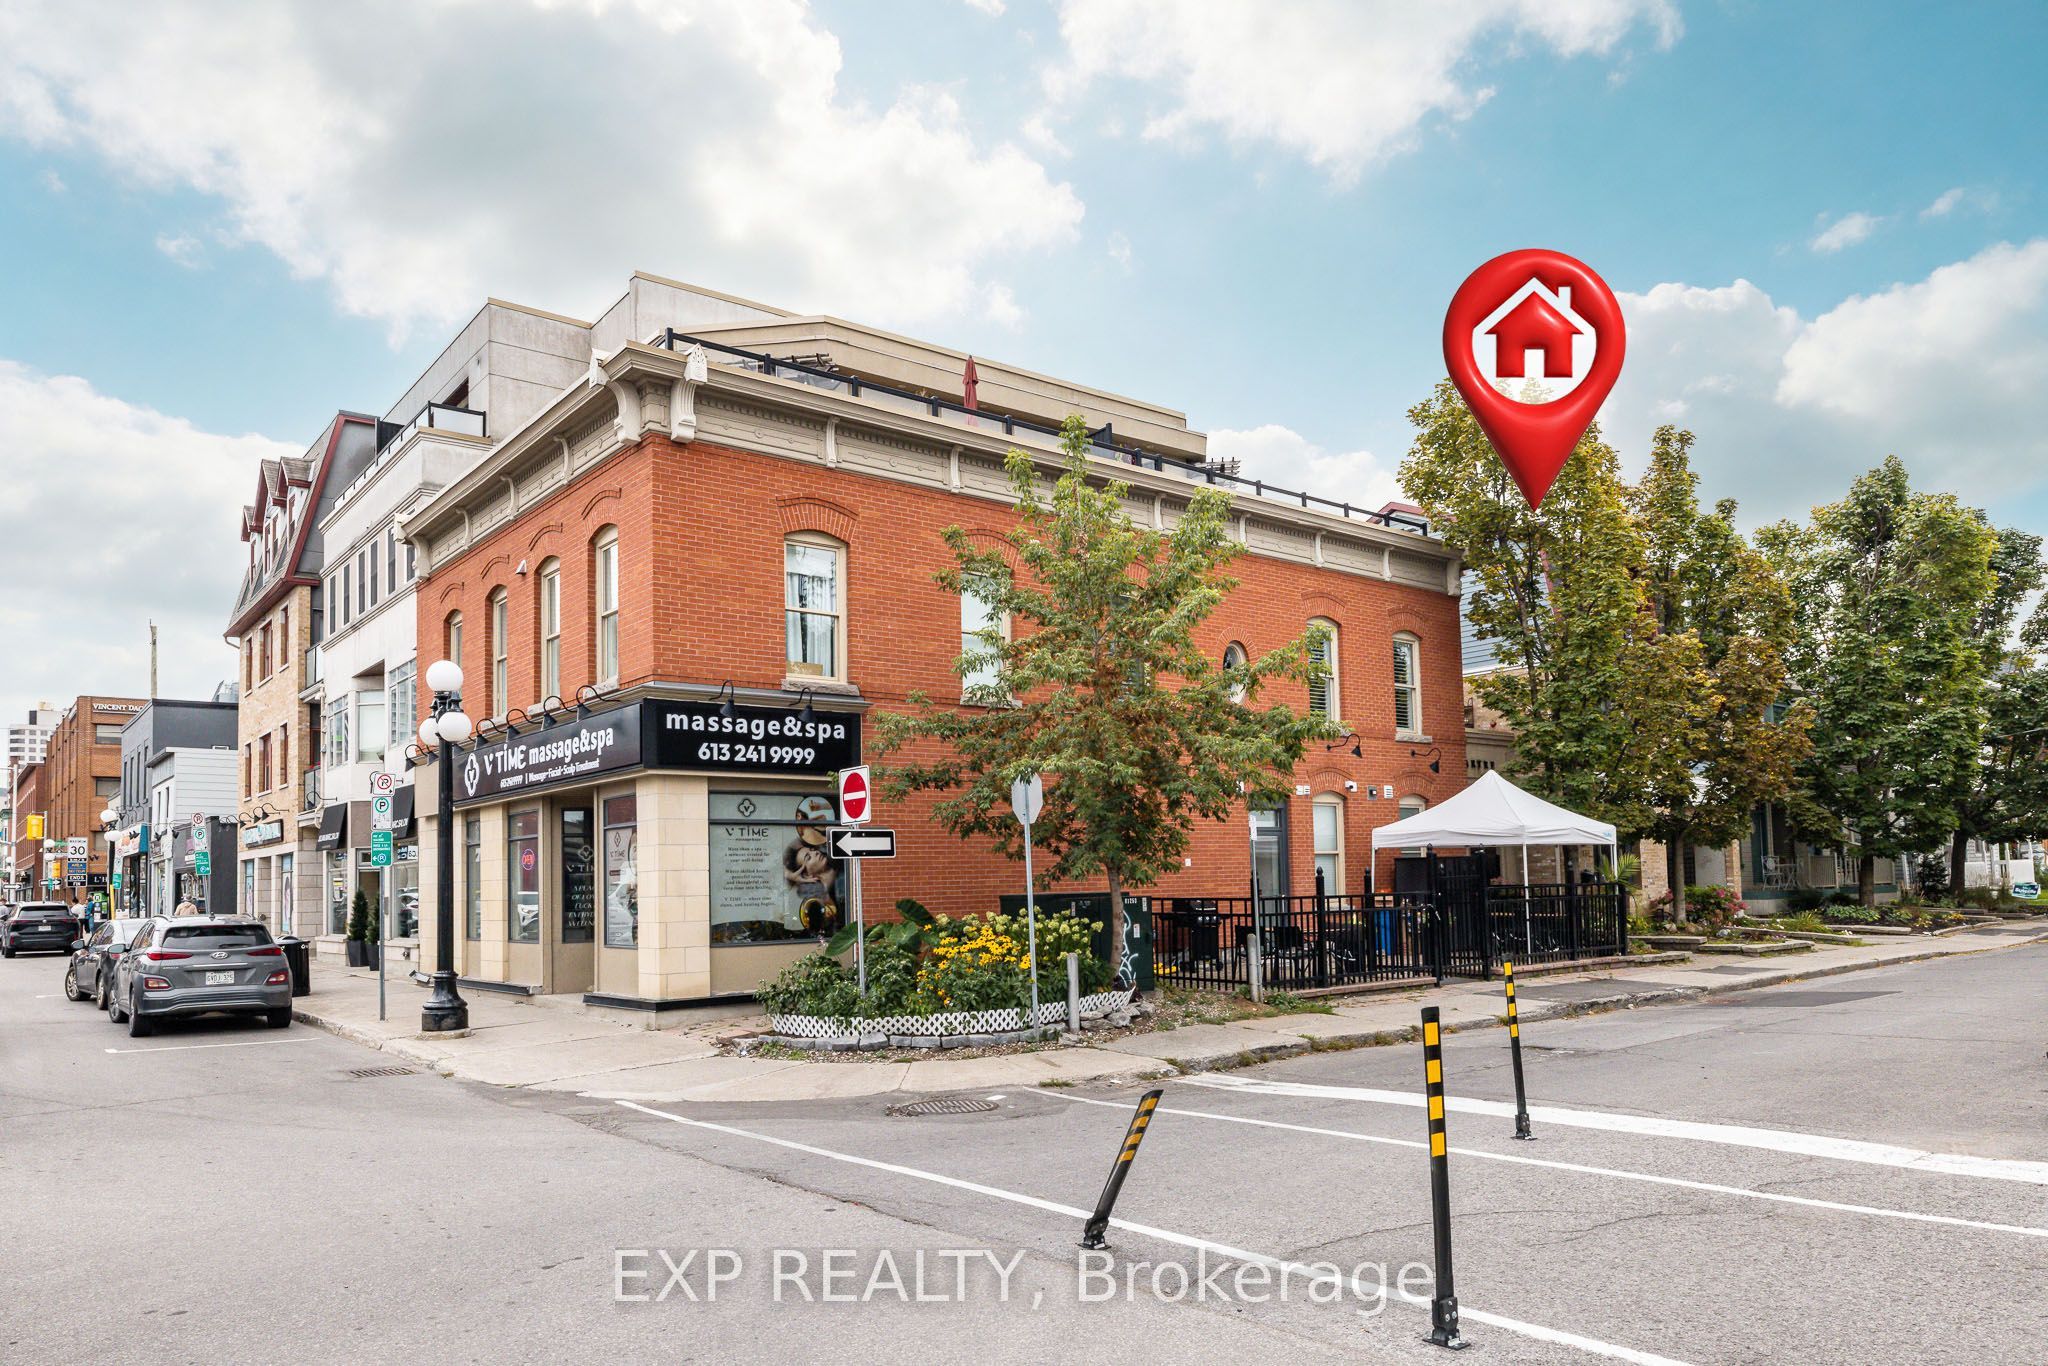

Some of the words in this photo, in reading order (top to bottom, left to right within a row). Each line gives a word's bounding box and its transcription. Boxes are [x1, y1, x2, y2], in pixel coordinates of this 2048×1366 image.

[92, 703, 127, 711] VINCENT
[666, 713, 845, 744] massage&spa
[528, 727, 614, 766] massage&spa
[698, 742, 731, 762] 613
[734, 744, 766, 763] 241
[769, 746, 815, 765] 9999
[739, 825, 769, 837] TIME
[70, 846, 85, 855] 30
